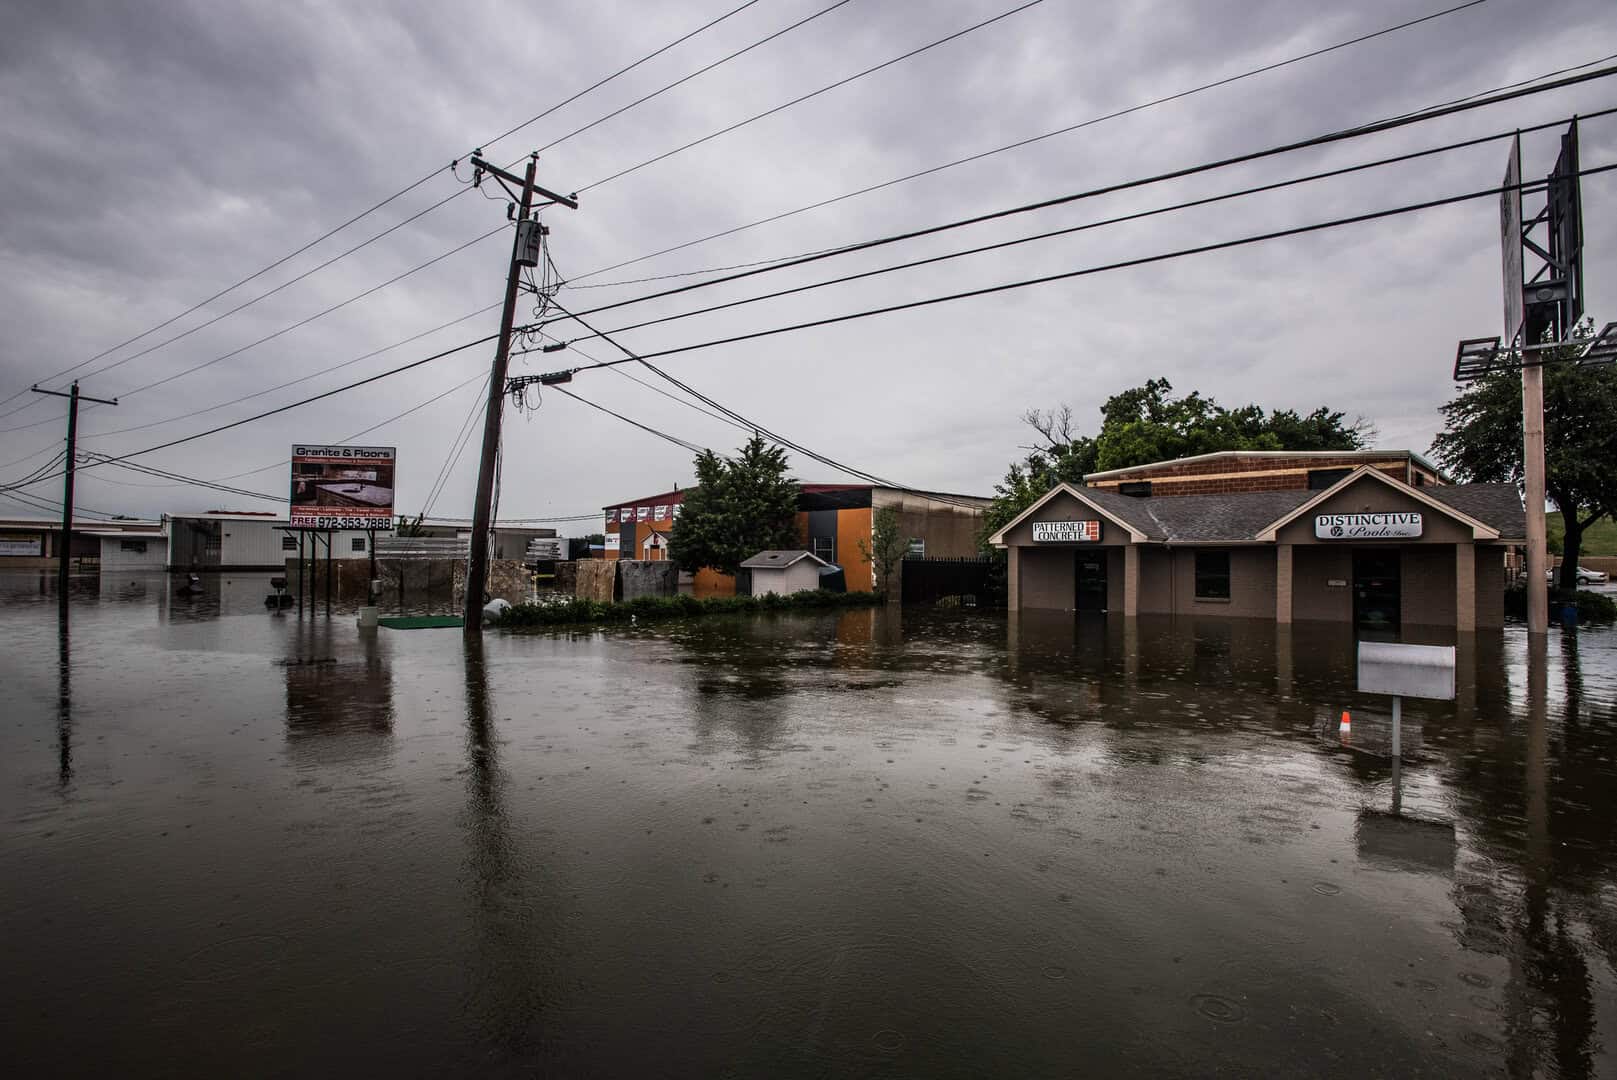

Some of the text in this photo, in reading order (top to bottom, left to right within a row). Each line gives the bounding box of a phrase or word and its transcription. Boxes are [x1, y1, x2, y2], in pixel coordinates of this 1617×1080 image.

[296, 447, 390, 458] Granite & Floors
[318, 517, 391, 529] 972-353-7888
[1319, 514, 1420, 526] DISTINCTIVE
[1034, 523, 1084, 532] PATTERNED
[1349, 526, 1391, 537] Pools
[1038, 531, 1083, 541] CONCRETE
